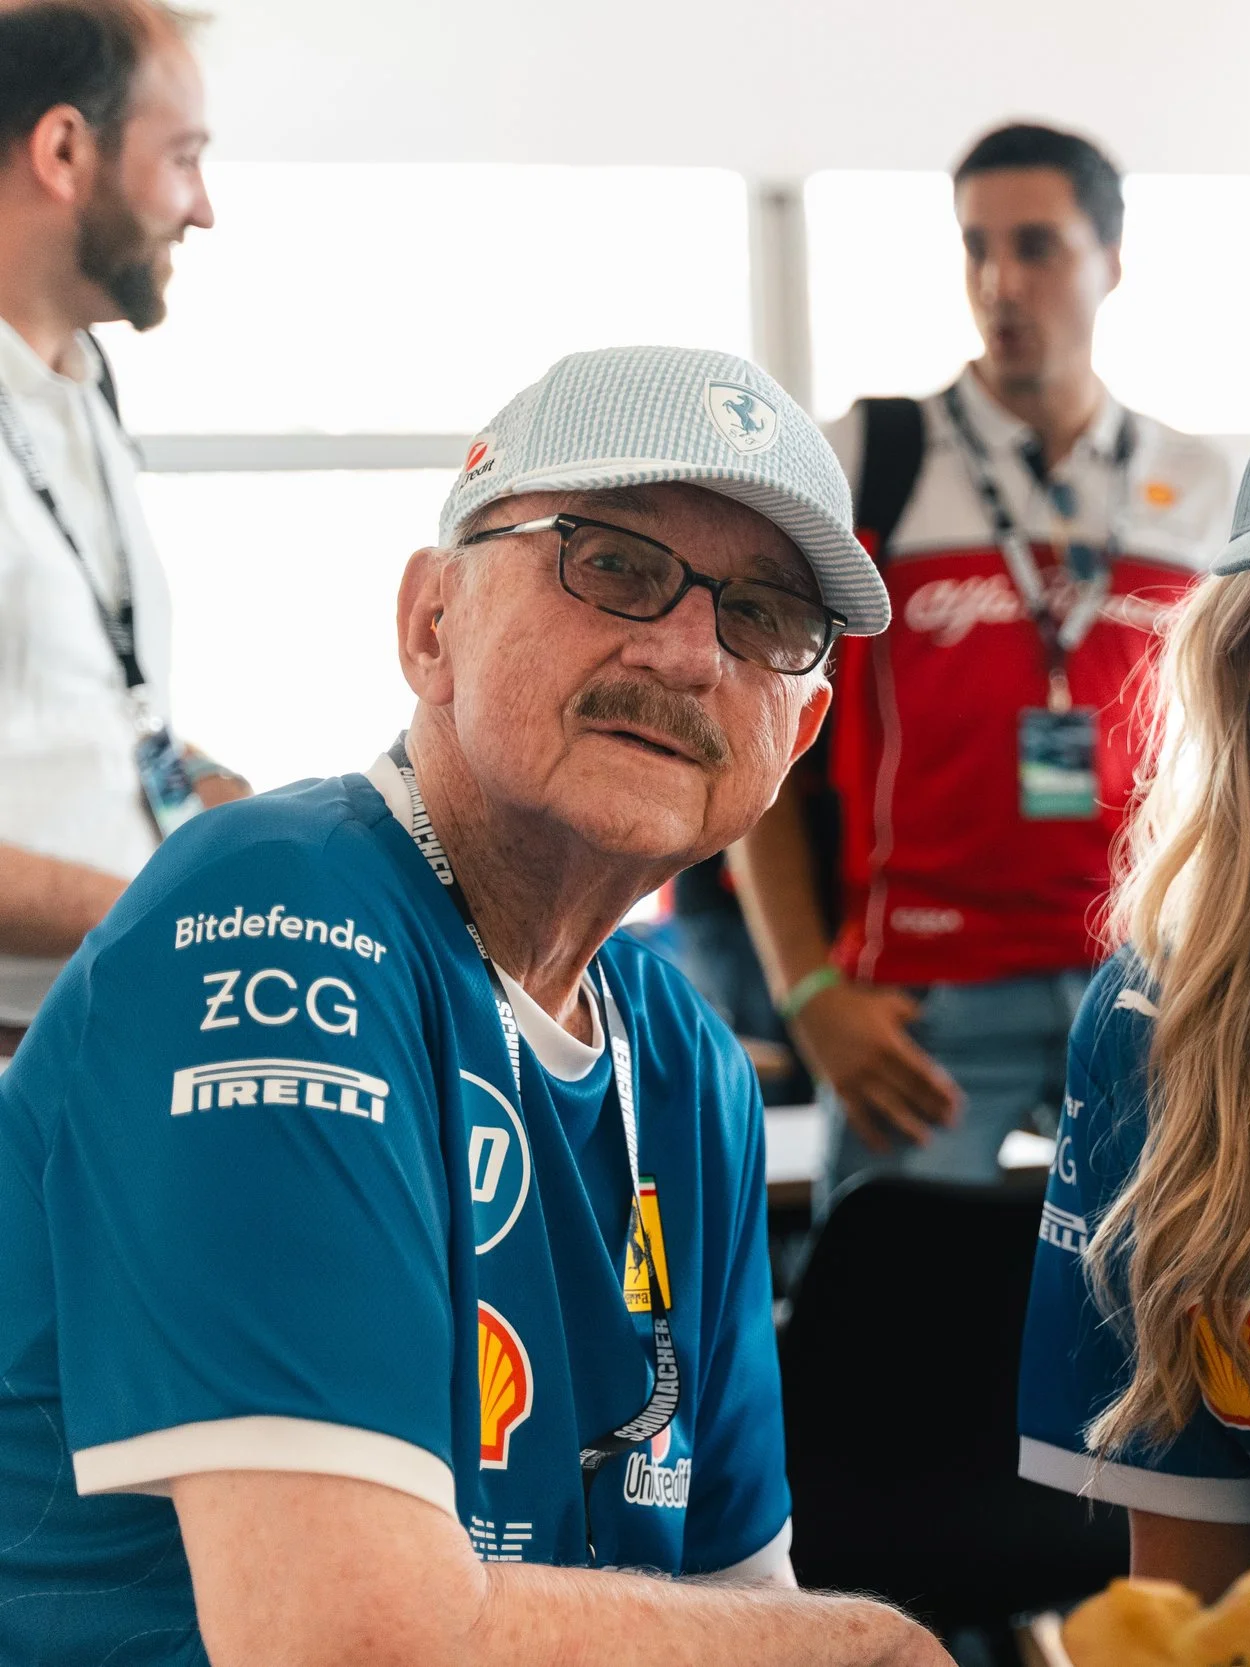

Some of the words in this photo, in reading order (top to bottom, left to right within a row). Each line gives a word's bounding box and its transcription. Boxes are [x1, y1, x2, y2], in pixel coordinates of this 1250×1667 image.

[174, 904, 388, 963] Bitdefender
[199, 968, 358, 1037] ZCG
[170, 1058, 390, 1124] PIRELLI
[614, 1318, 680, 1442] SCHUMACHER
